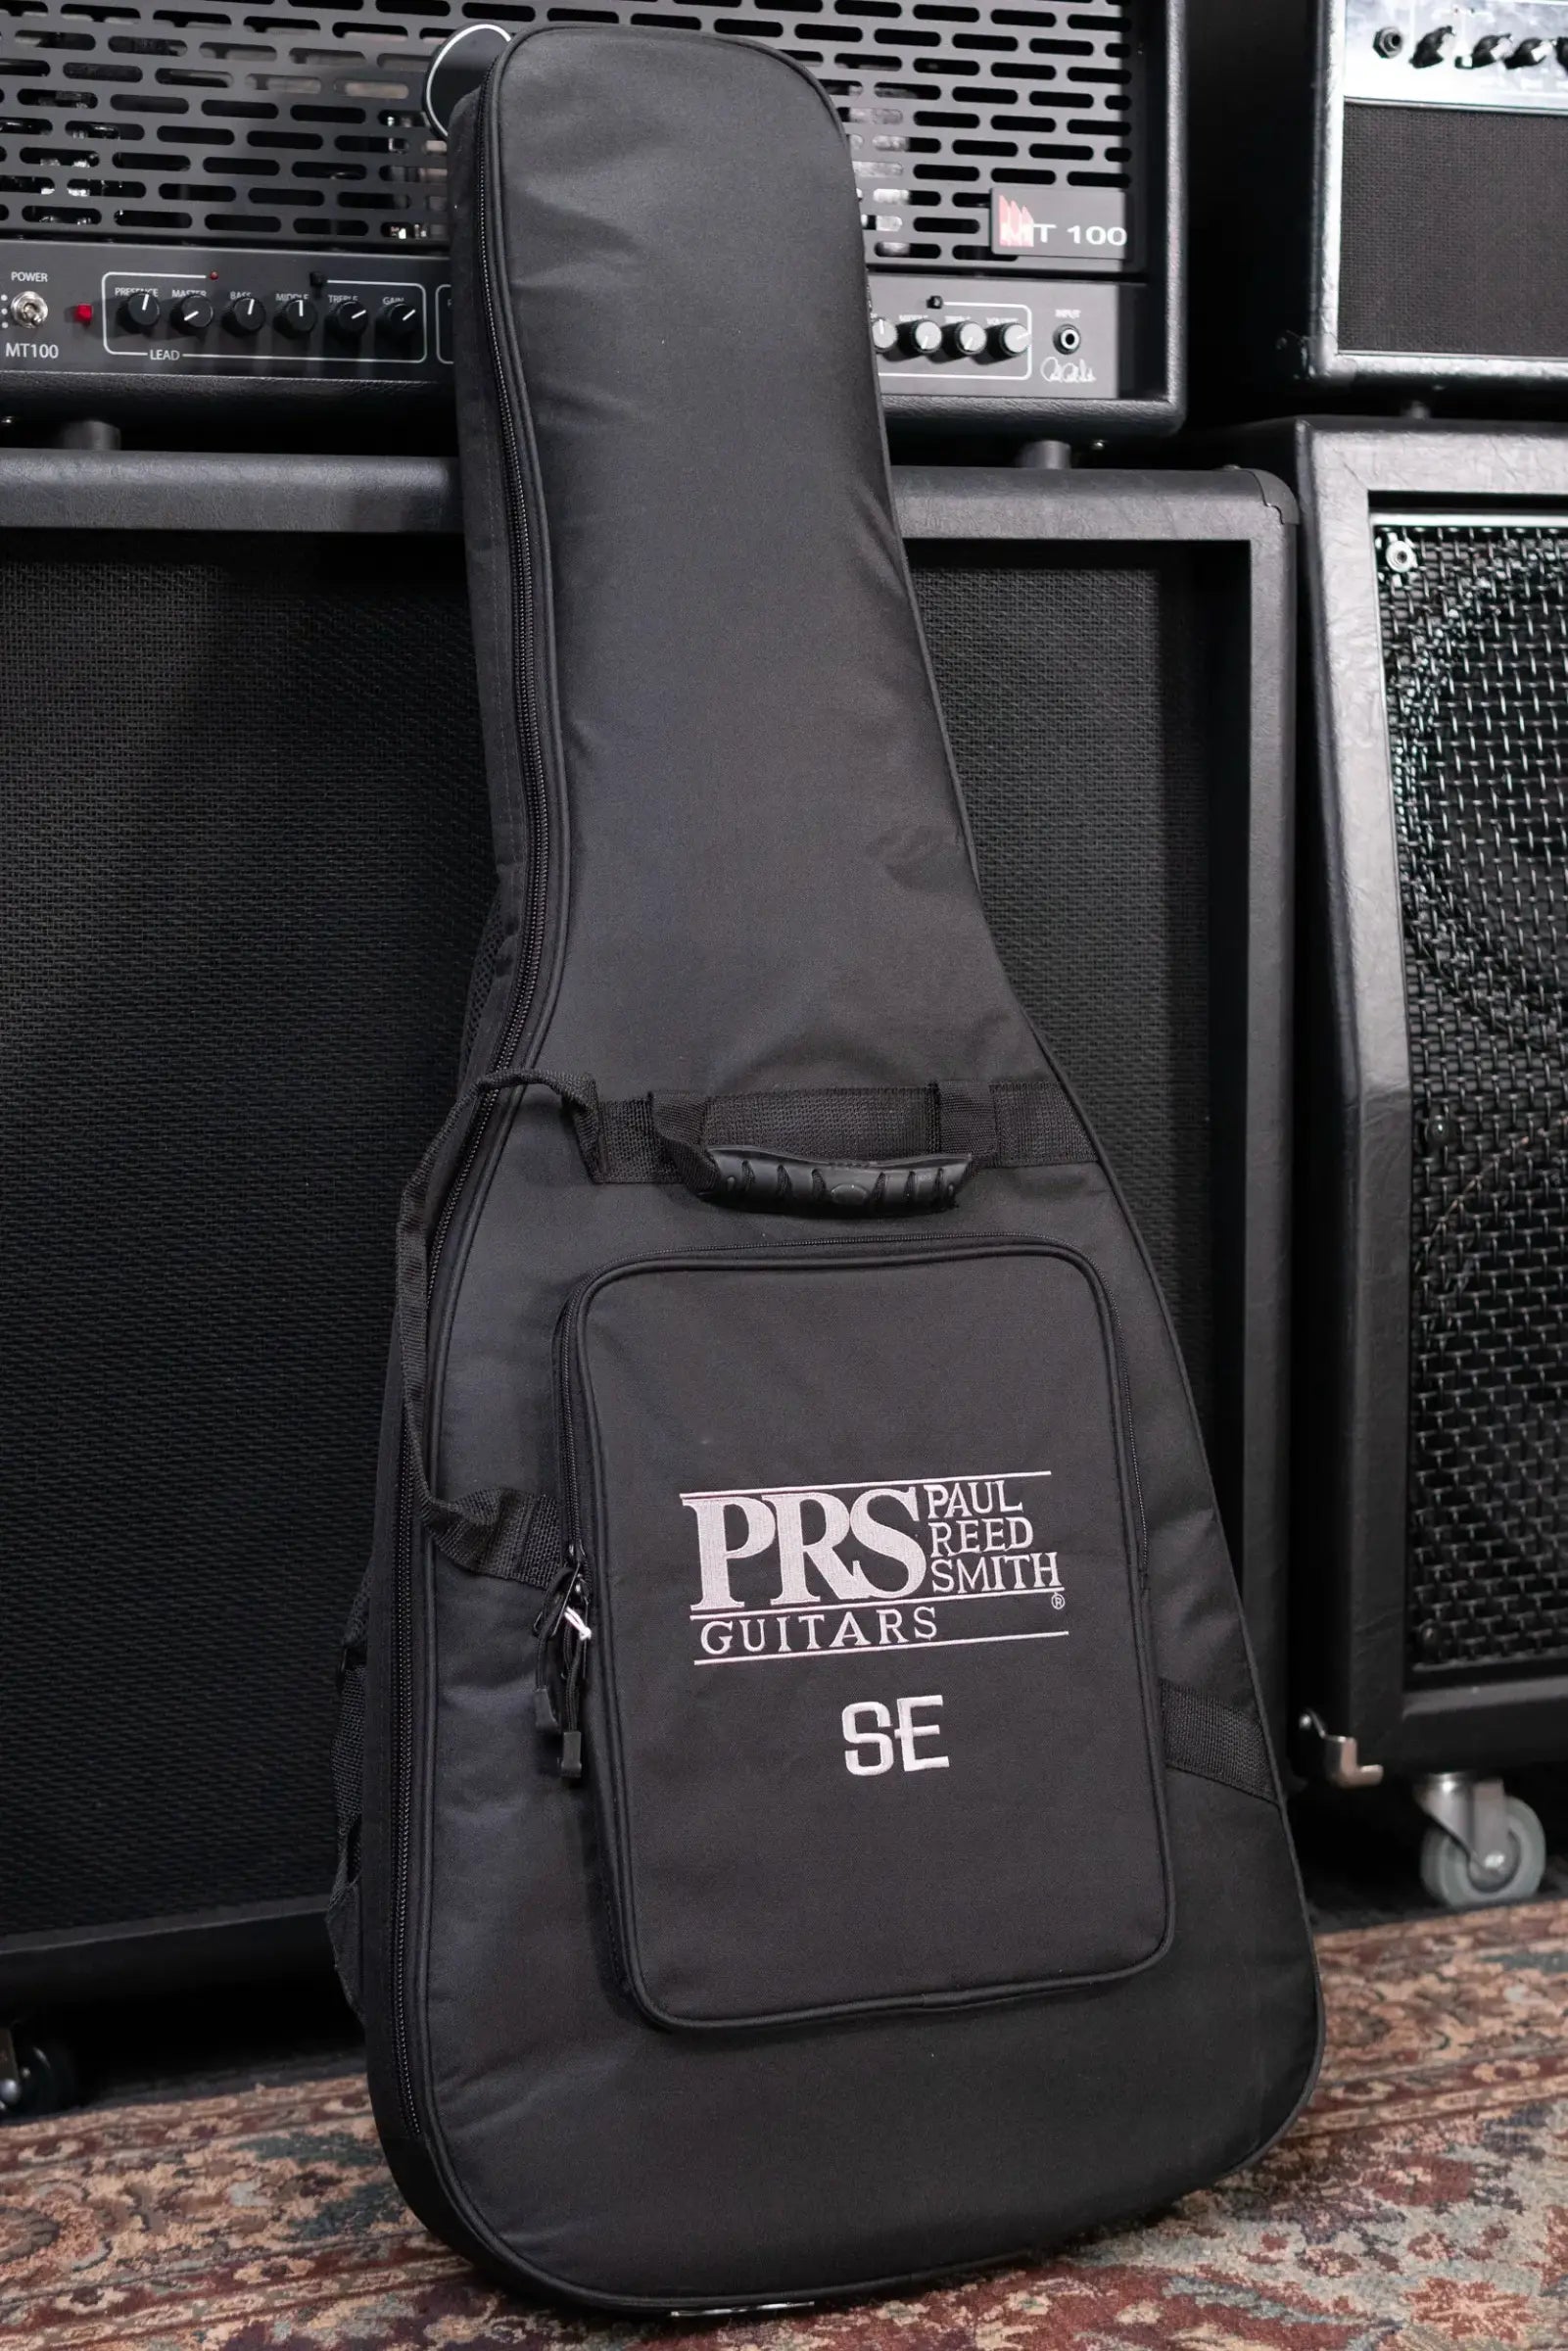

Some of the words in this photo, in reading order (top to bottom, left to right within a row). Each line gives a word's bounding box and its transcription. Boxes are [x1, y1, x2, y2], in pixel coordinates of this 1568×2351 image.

[1067, 225, 1127, 246] 100
[11, 271, 48, 283] POWER
[5, 342, 59, 360] MT100
[150, 349, 180, 360] LEAD
[924, 1480, 1023, 1519] PAUL
[682, 1487, 927, 1611] PRS
[928, 1516, 1034, 1559] REED
[930, 1552, 1062, 1594] SMITH
[700, 1607, 937, 1655] GUITARS
[840, 1695, 950, 1777] SE
